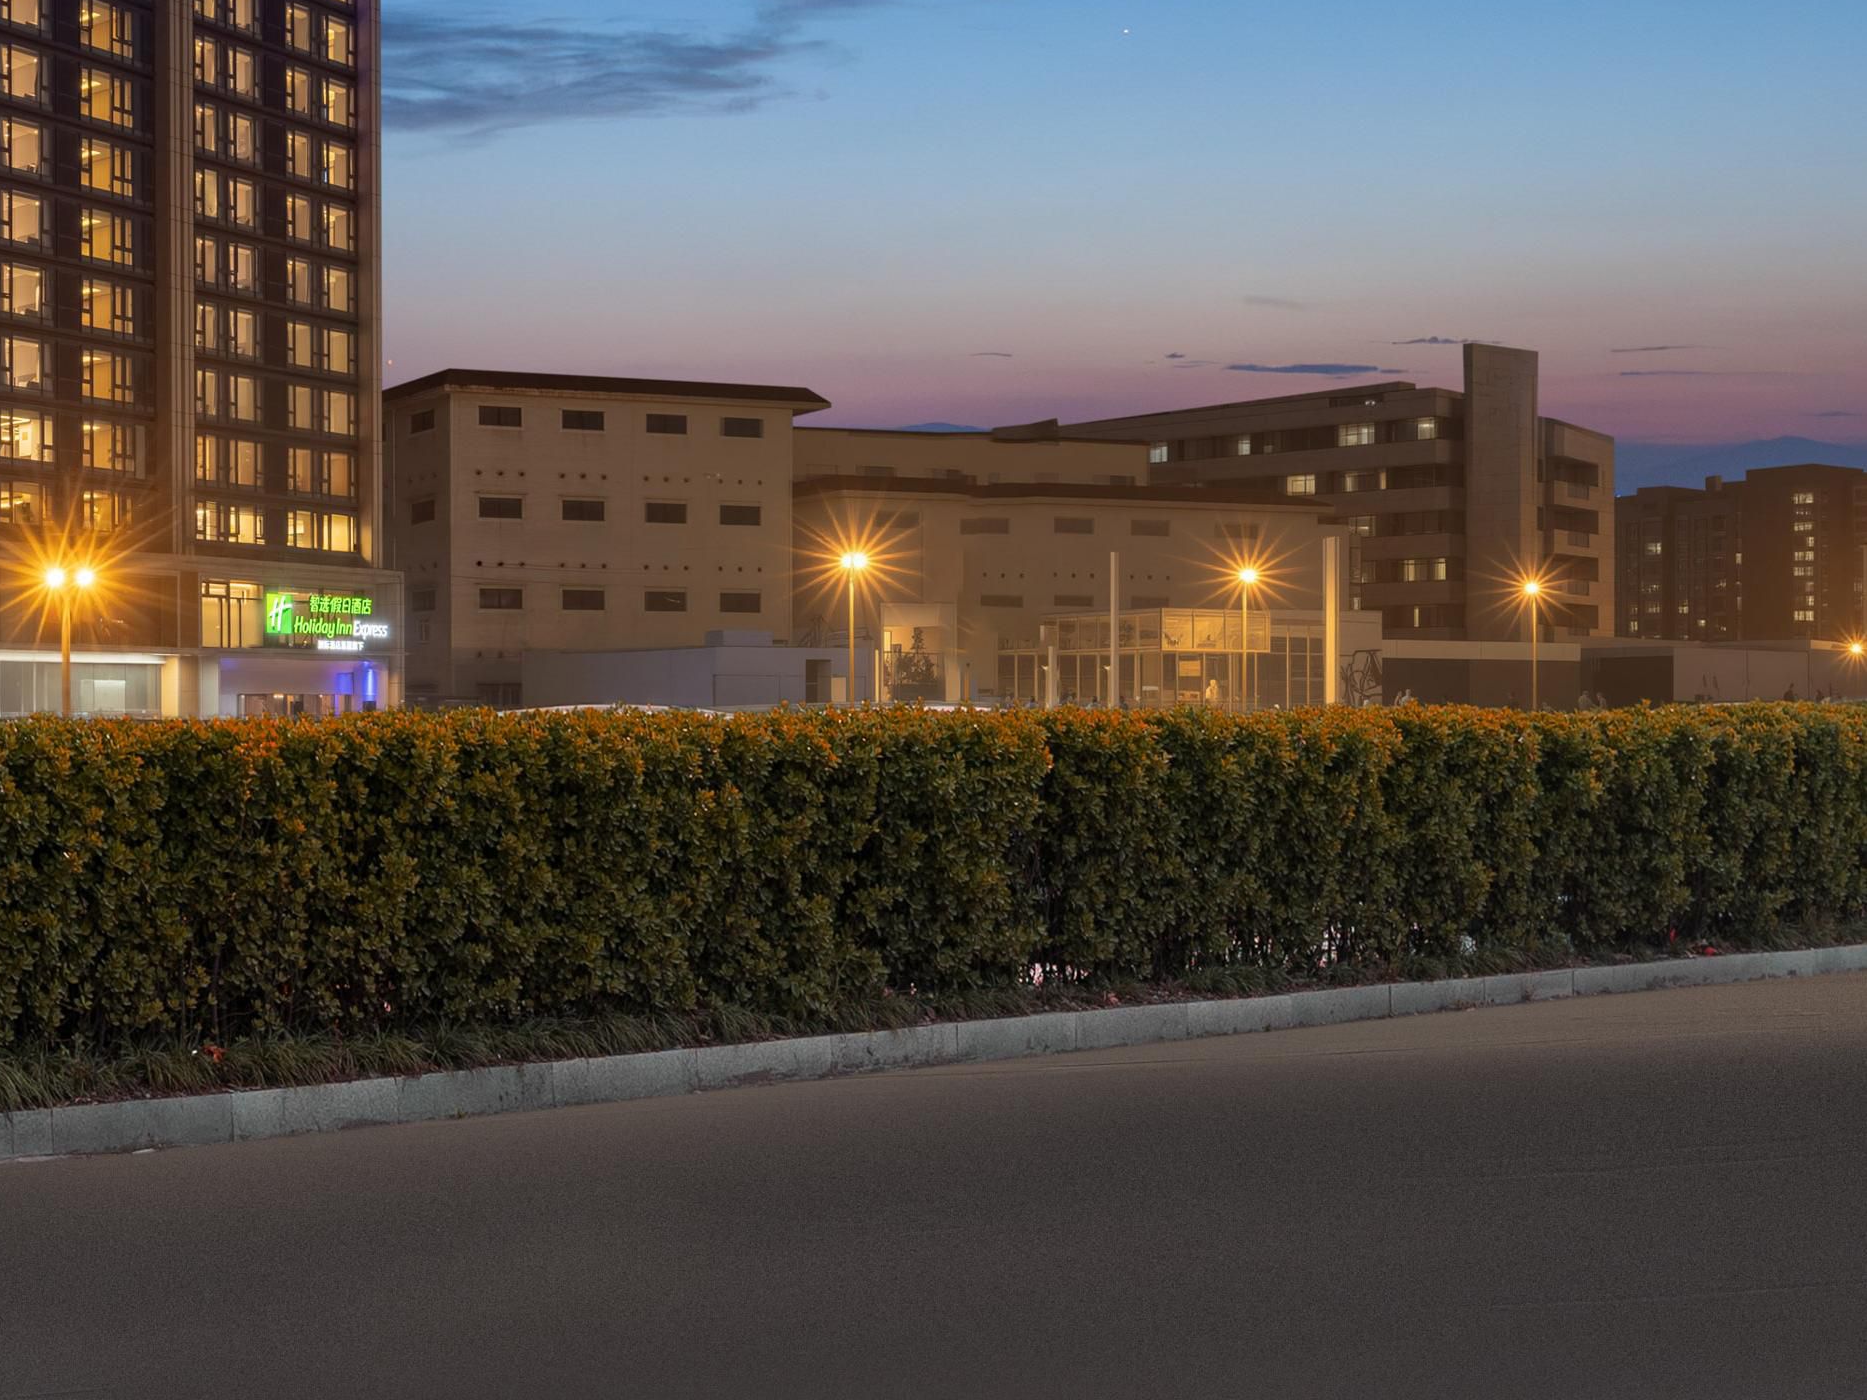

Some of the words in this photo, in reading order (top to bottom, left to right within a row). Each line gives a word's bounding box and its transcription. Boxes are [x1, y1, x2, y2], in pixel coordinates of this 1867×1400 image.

[309, 594, 372, 615] 智选假日酒店
[294, 616, 335, 638] Holiday
[336, 618, 353, 635] Inn
[353, 621, 388, 640] Express
